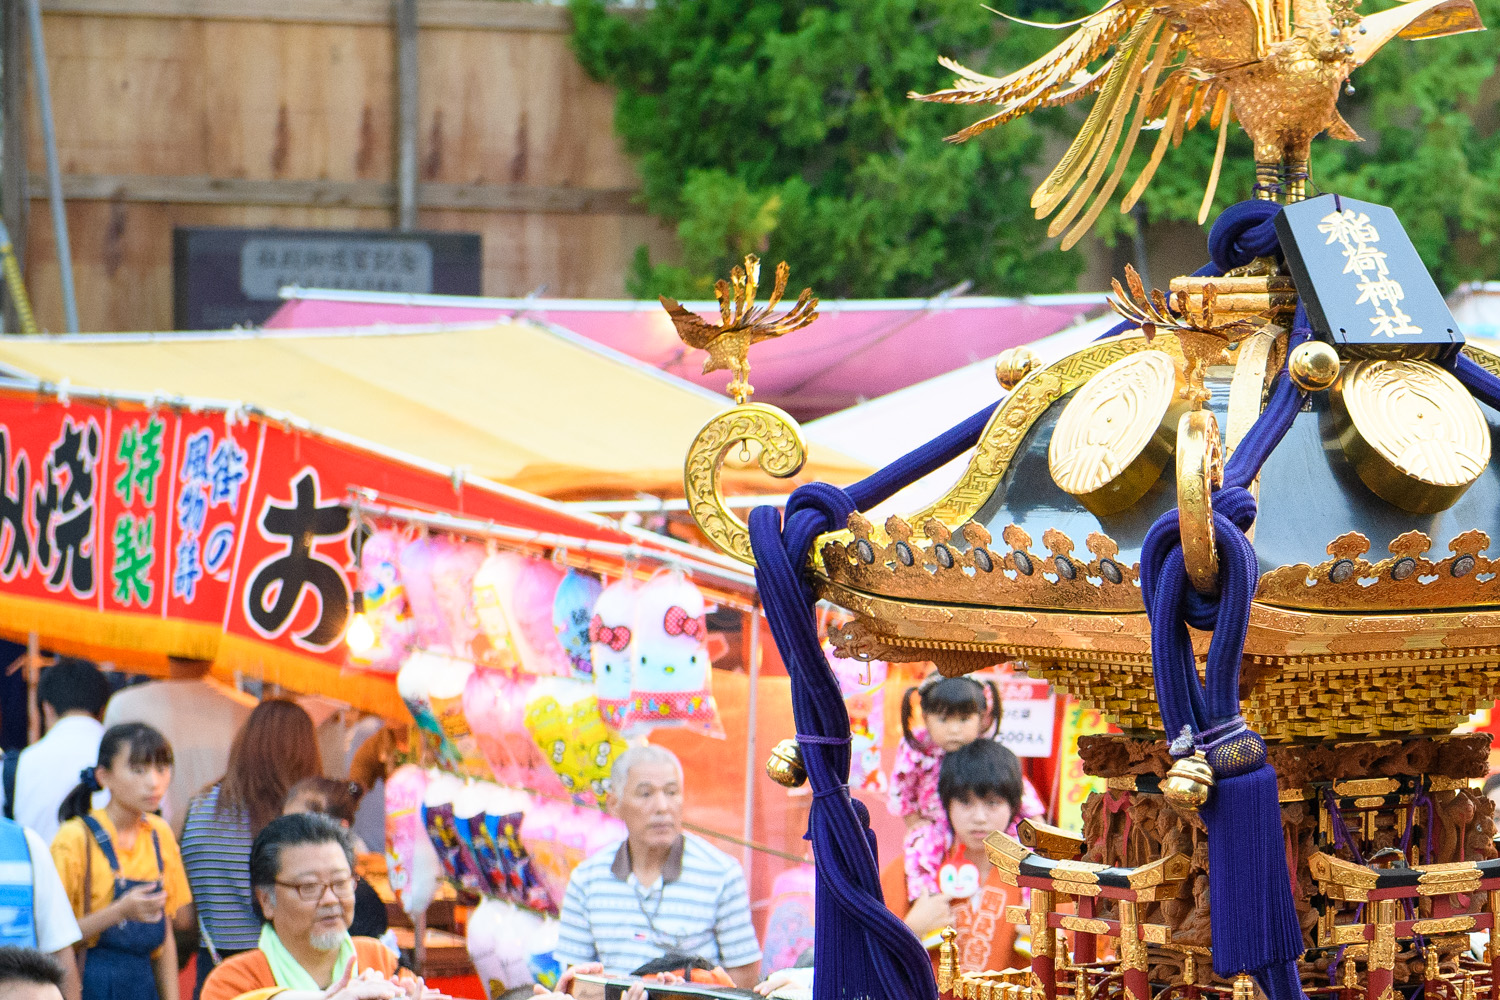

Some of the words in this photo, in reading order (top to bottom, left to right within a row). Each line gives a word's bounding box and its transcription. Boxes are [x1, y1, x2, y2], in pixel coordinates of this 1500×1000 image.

[1317, 209, 1423, 338] 稲荷神社
[113, 418, 166, 606] 特製
[245, 466, 376, 652] お
